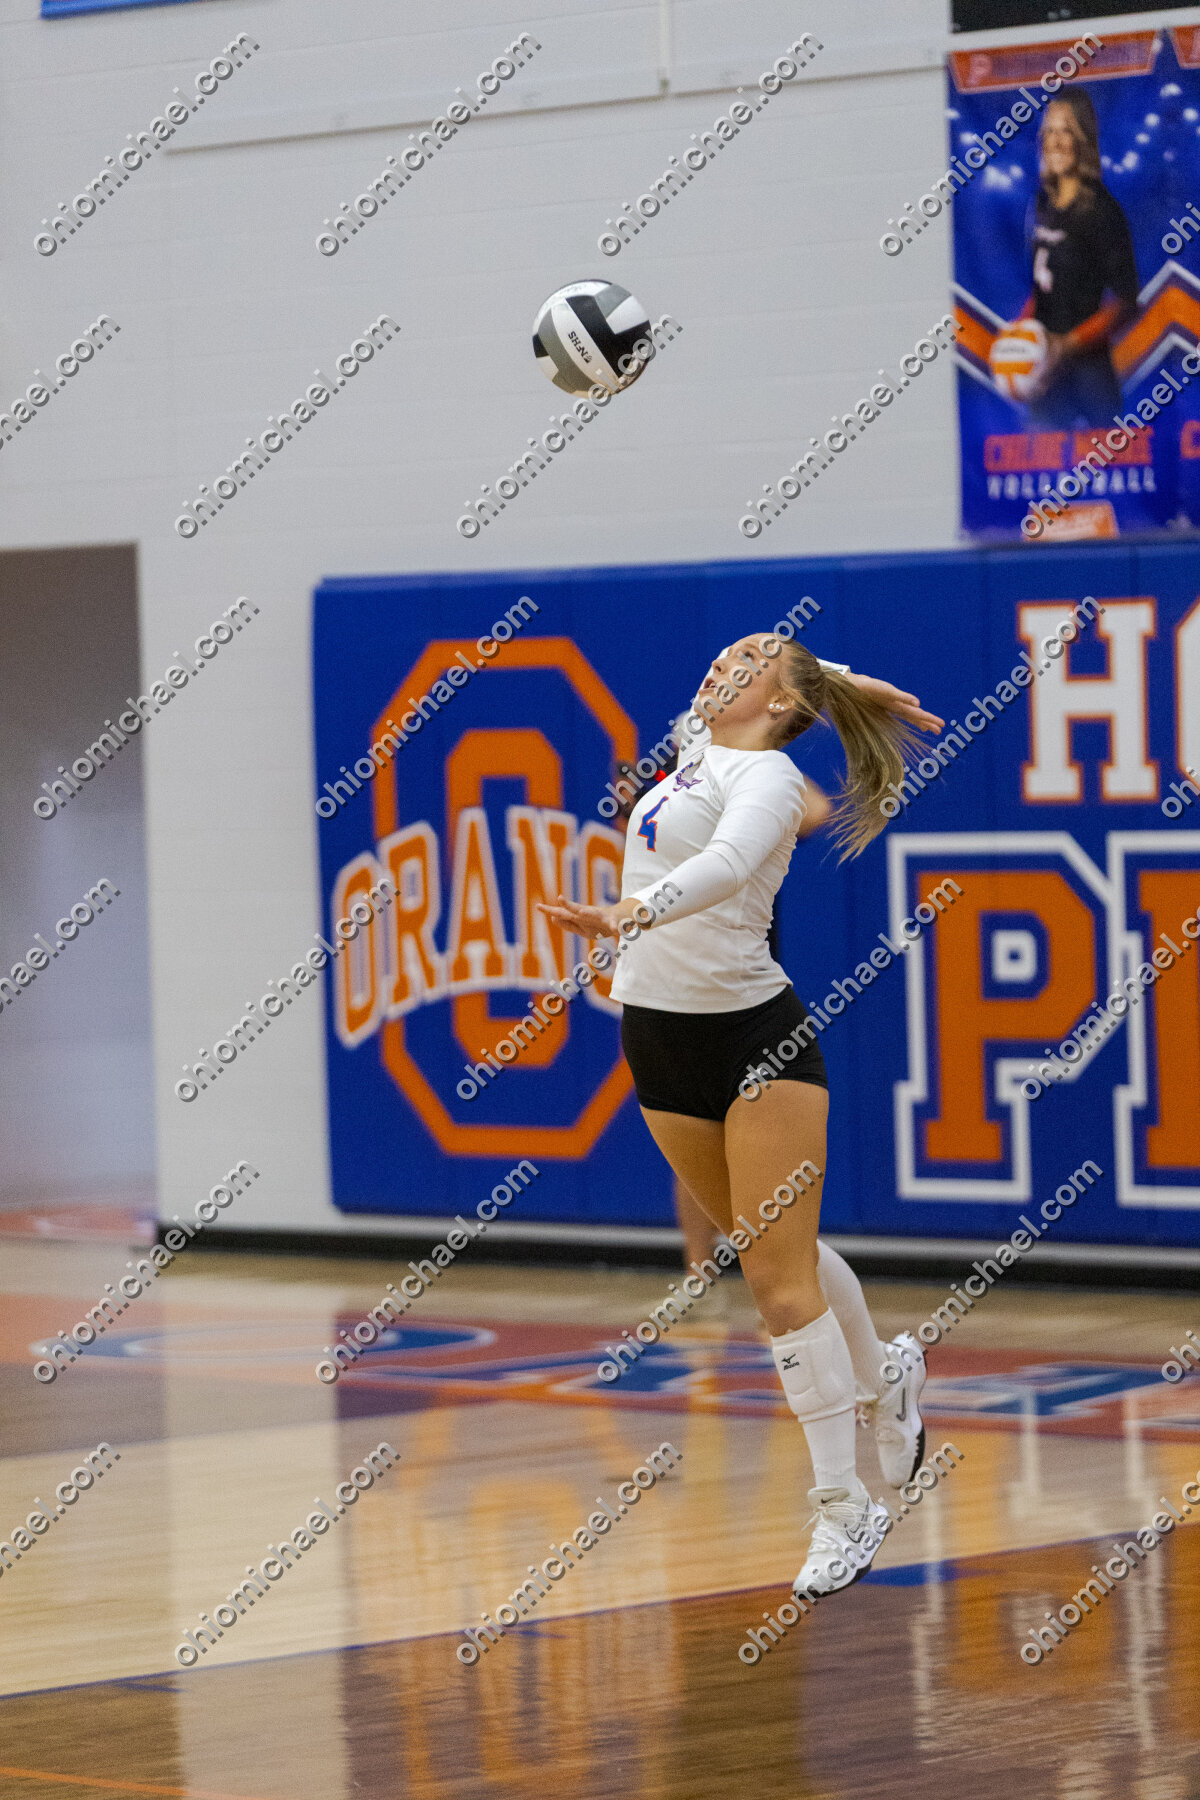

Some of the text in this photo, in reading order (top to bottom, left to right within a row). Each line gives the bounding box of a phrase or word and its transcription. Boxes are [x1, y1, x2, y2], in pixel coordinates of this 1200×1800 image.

[568, 331, 589, 358] NFHS
[1016, 595, 1200, 804] H
[637, 795, 669, 852] 4
[332, 804, 625, 1048] ORANG
